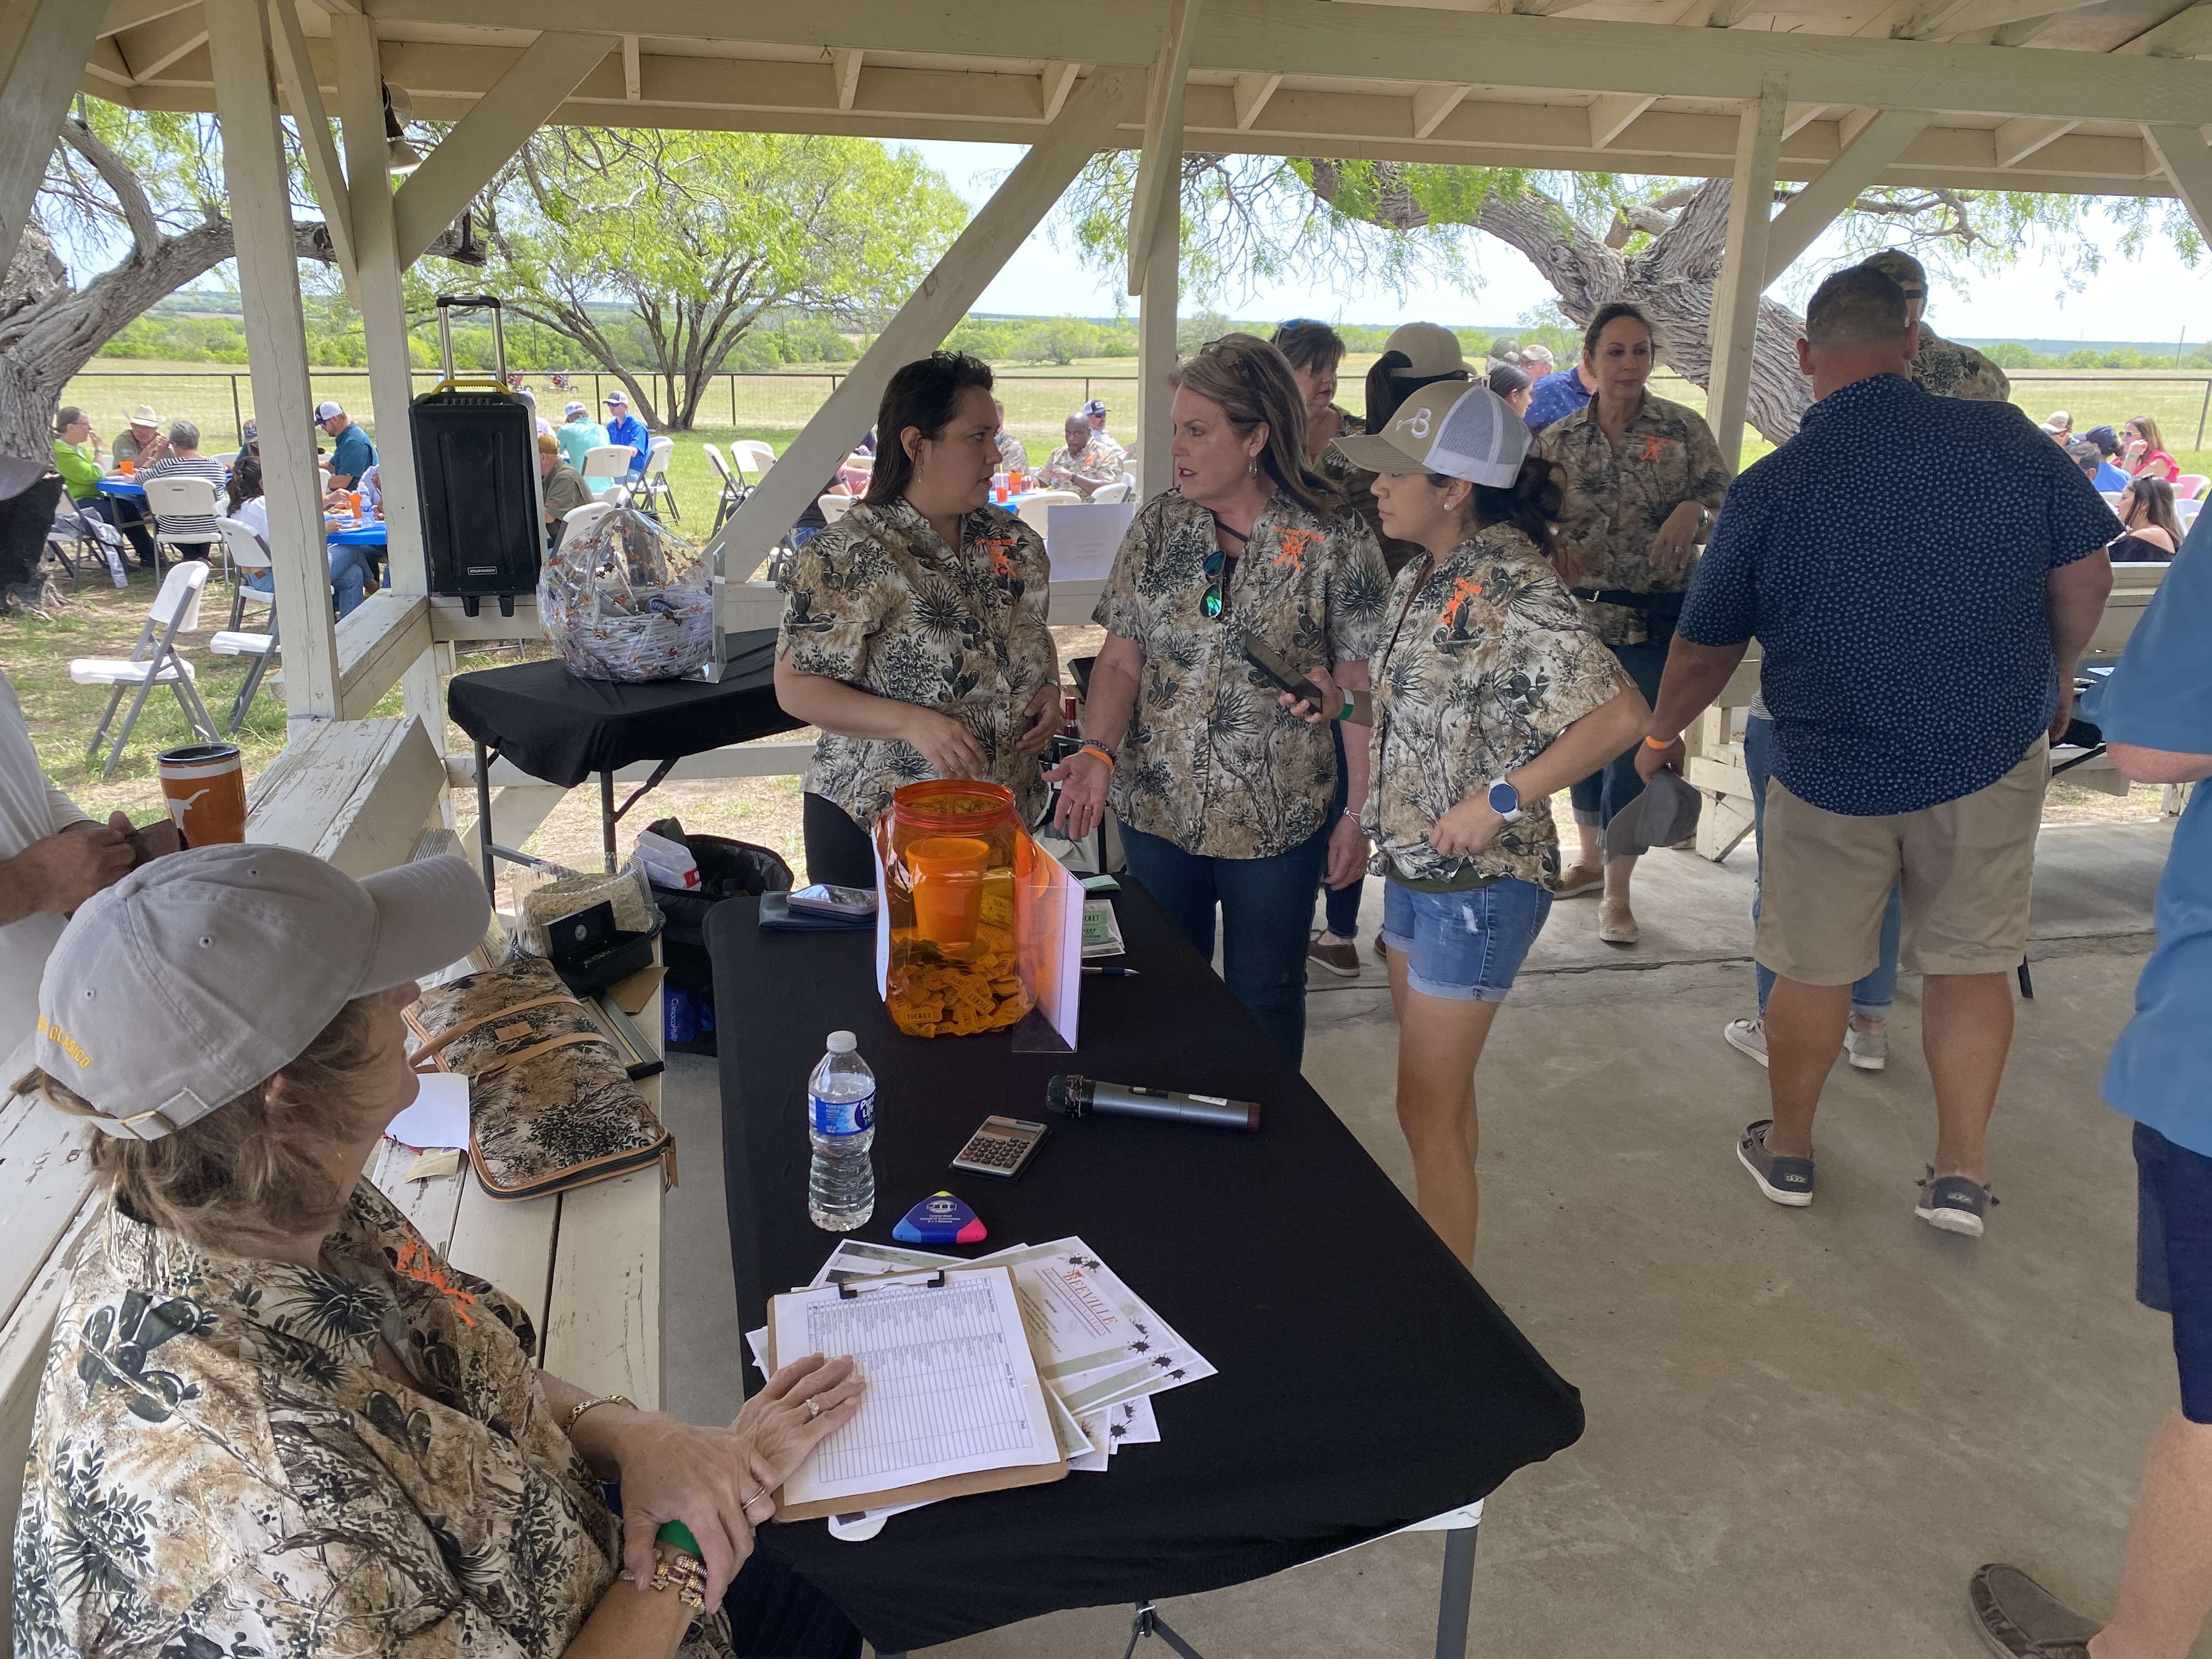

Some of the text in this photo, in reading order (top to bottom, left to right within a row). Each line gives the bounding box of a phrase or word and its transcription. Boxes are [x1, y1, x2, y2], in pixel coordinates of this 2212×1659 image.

[967, 994, 989, 1011] TICKET
[1044, 1268, 1074, 1299] EDUCATION
[1071, 1298, 1107, 1335] FOUNDATION
[1063, 1271, 1118, 1325] BEEVILLE
[1004, 1362, 1012, 1376] Amount
